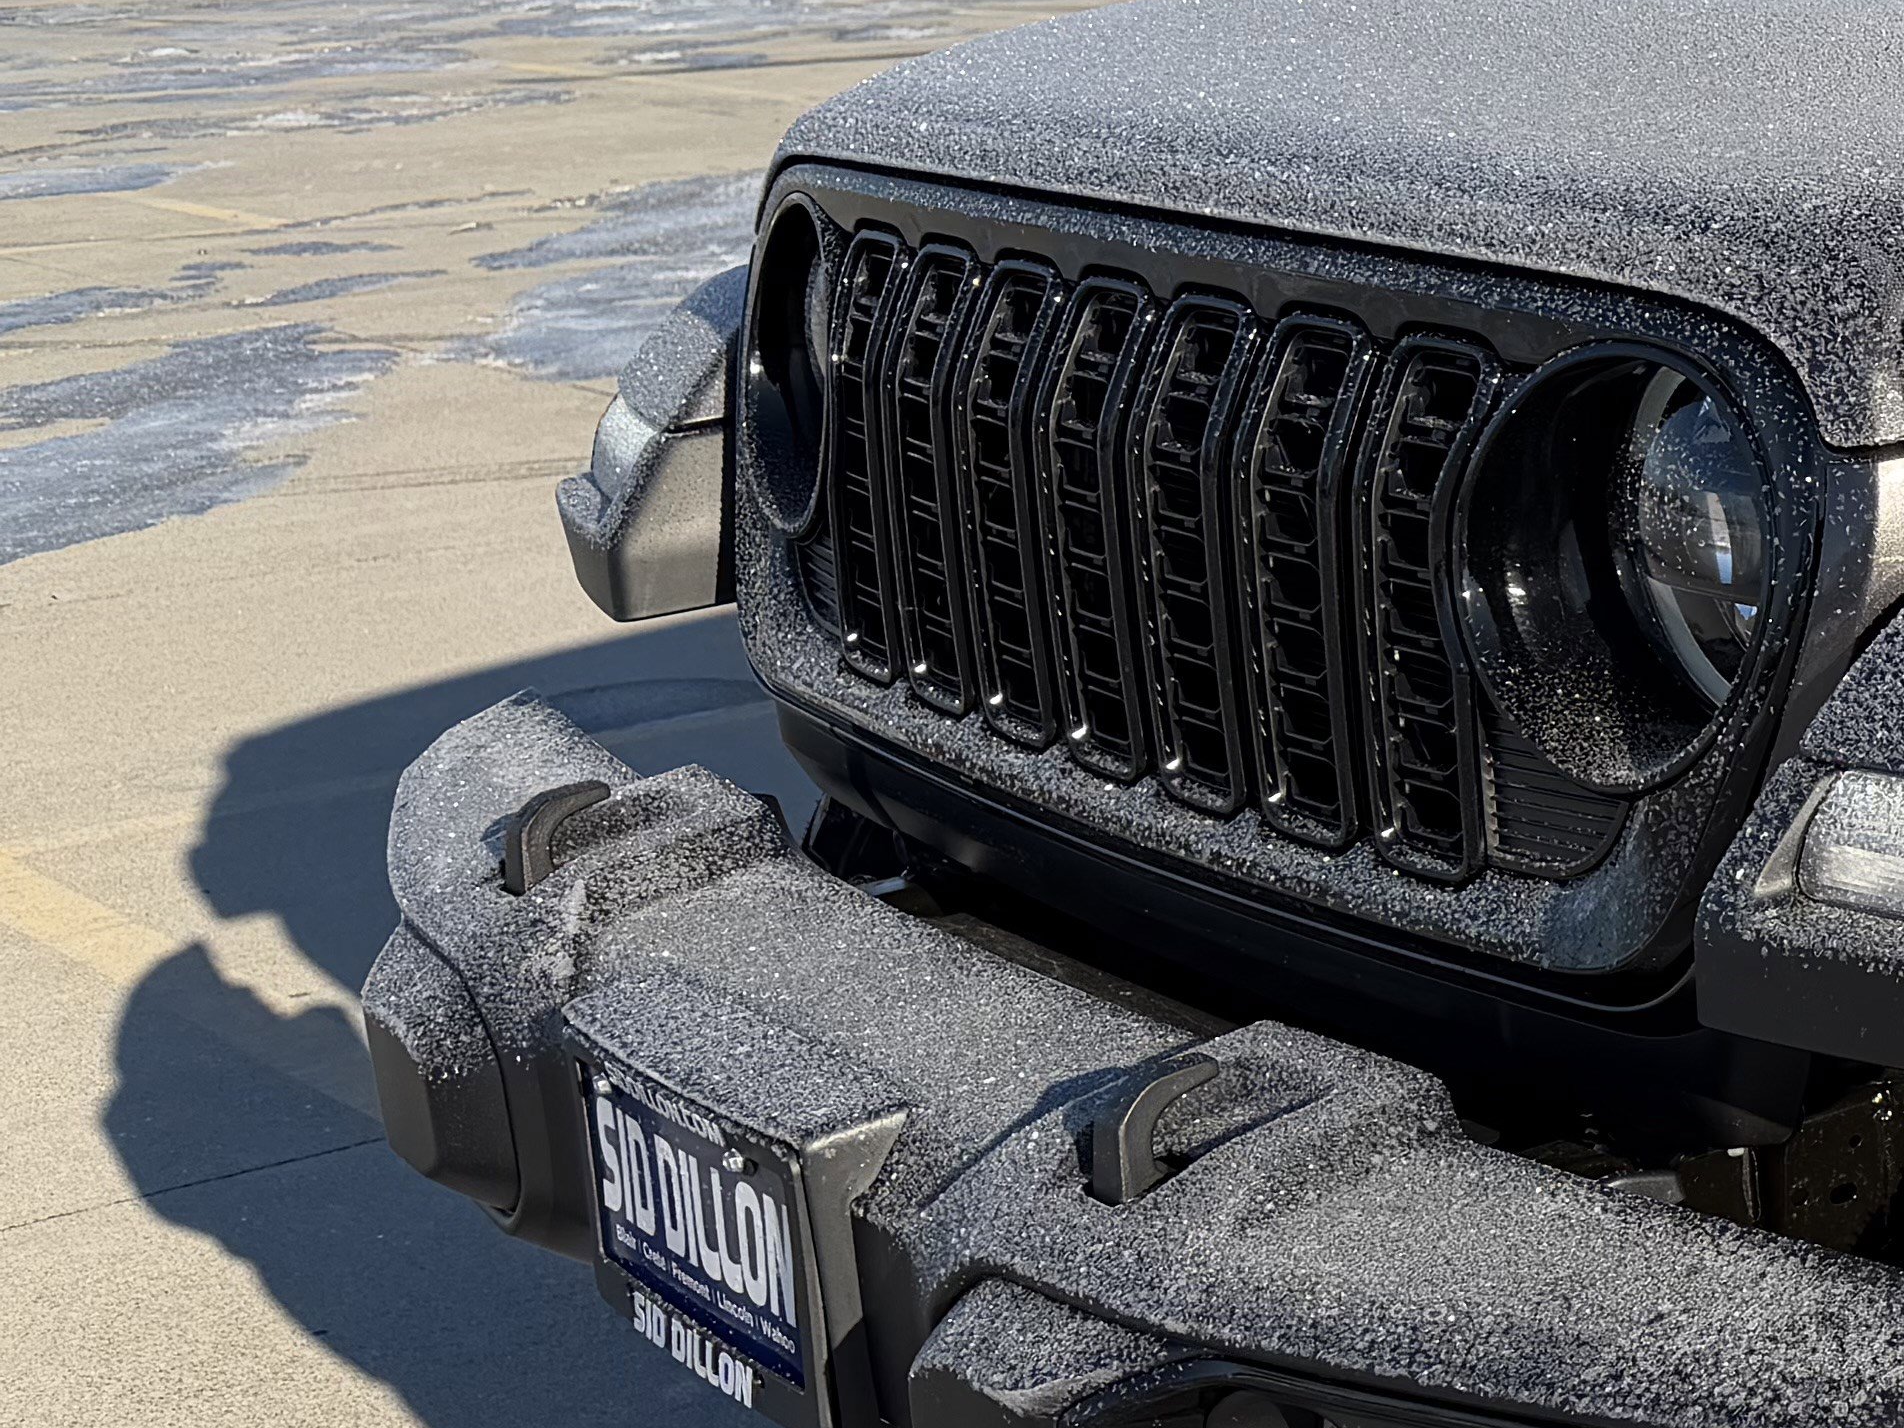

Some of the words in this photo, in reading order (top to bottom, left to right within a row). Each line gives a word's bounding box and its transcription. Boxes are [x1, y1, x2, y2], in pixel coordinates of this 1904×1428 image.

[596, 1096, 657, 1237] SID
[654, 1133, 798, 1329] DILLON
[616, 1223, 637, 1251] Blair
[716, 1290, 754, 1328] Lincoln
[760, 1316, 797, 1355] Wahoo
[633, 1290, 666, 1349] SID
[671, 1317, 754, 1410] DILLON
